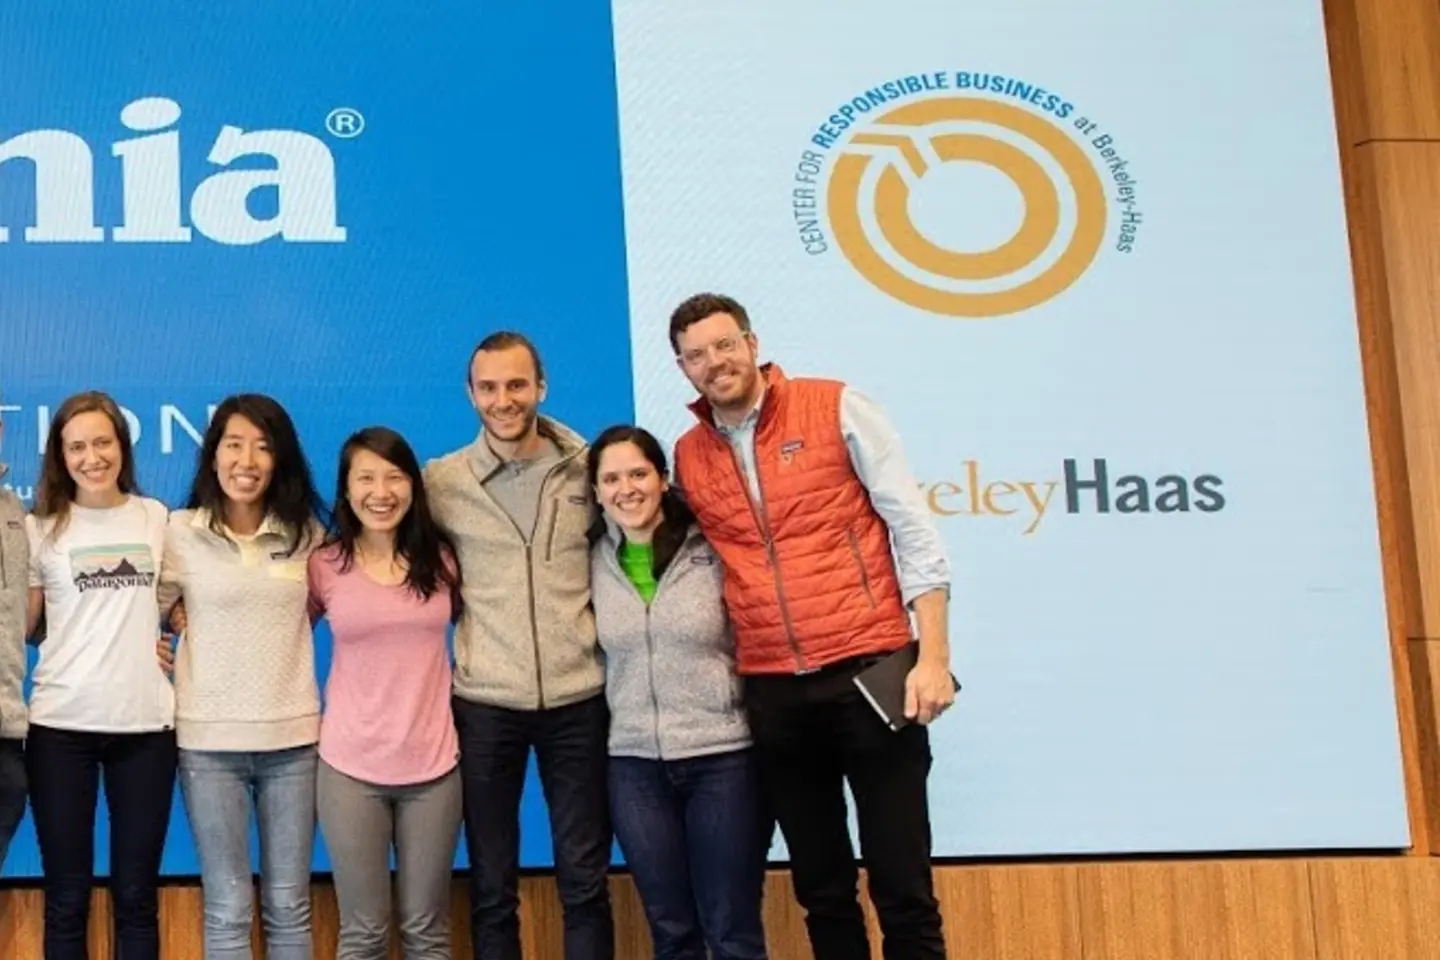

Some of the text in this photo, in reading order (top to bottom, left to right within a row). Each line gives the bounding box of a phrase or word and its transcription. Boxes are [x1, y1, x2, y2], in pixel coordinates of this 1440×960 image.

[812, 72, 949, 149] RESPONSIBLE
[956, 71, 1075, 119] BUSINESS
[1074, 116, 1097, 135] at
[795, 150, 825, 184] FOR
[793, 187, 828, 256] CENTER
